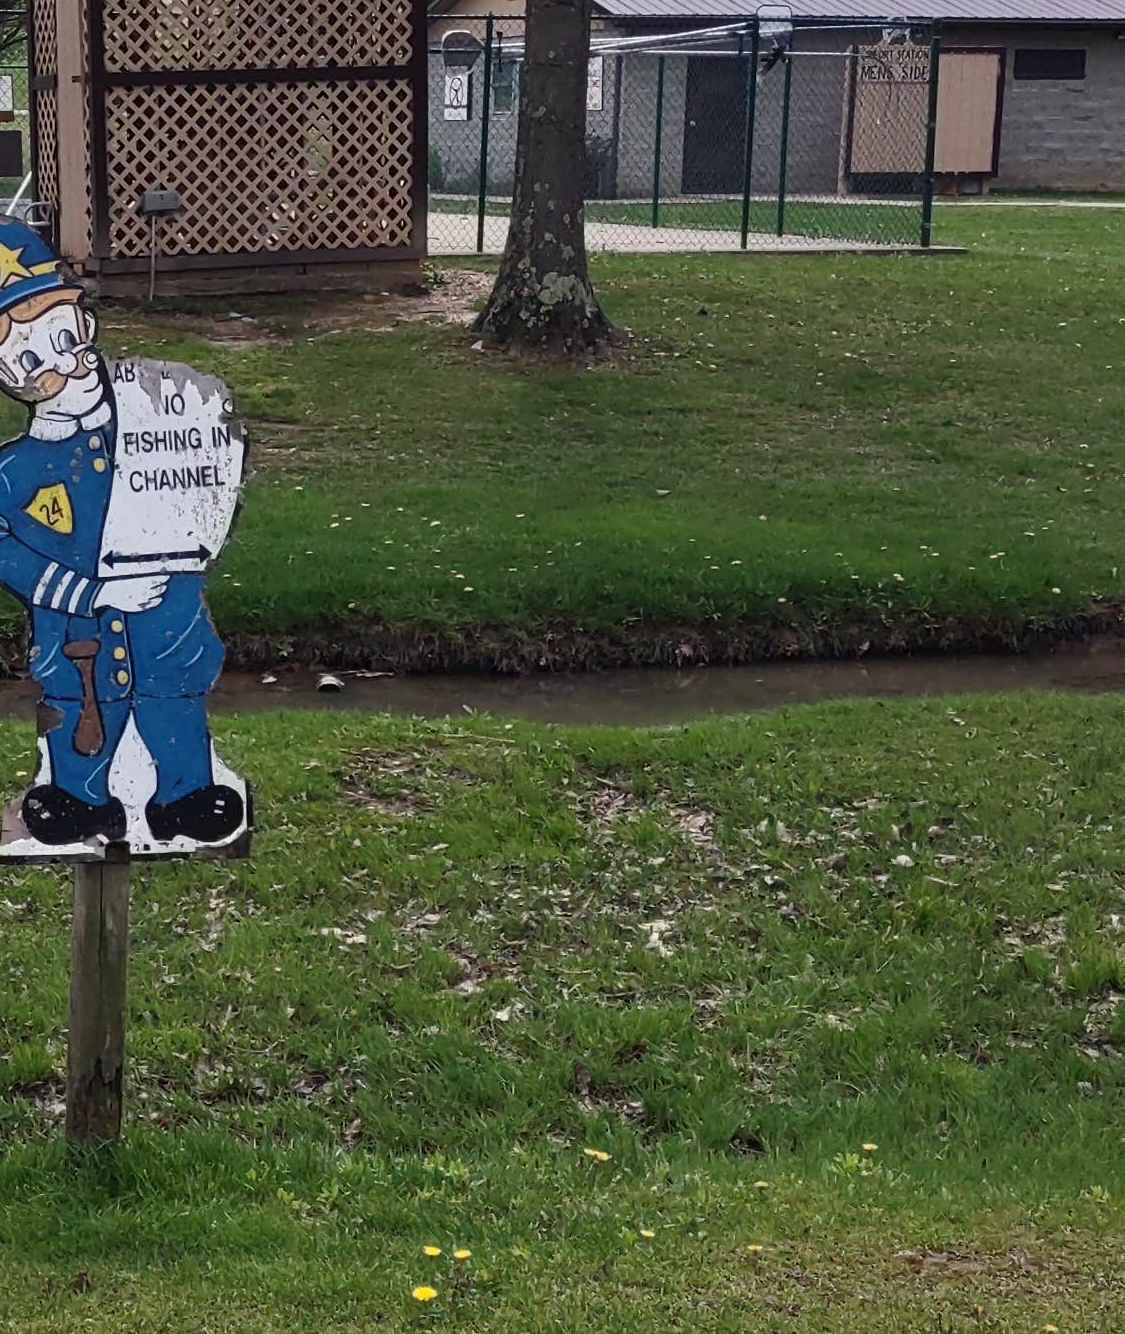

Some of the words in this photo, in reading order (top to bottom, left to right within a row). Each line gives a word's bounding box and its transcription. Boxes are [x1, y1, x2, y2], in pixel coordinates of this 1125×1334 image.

[901, 65, 928, 80] SIDE
[123, 427, 203, 454] FISHING
[211, 426, 231, 447] IN
[129, 466, 226, 492] CHANNEL
[39, 496, 64, 526] 24
